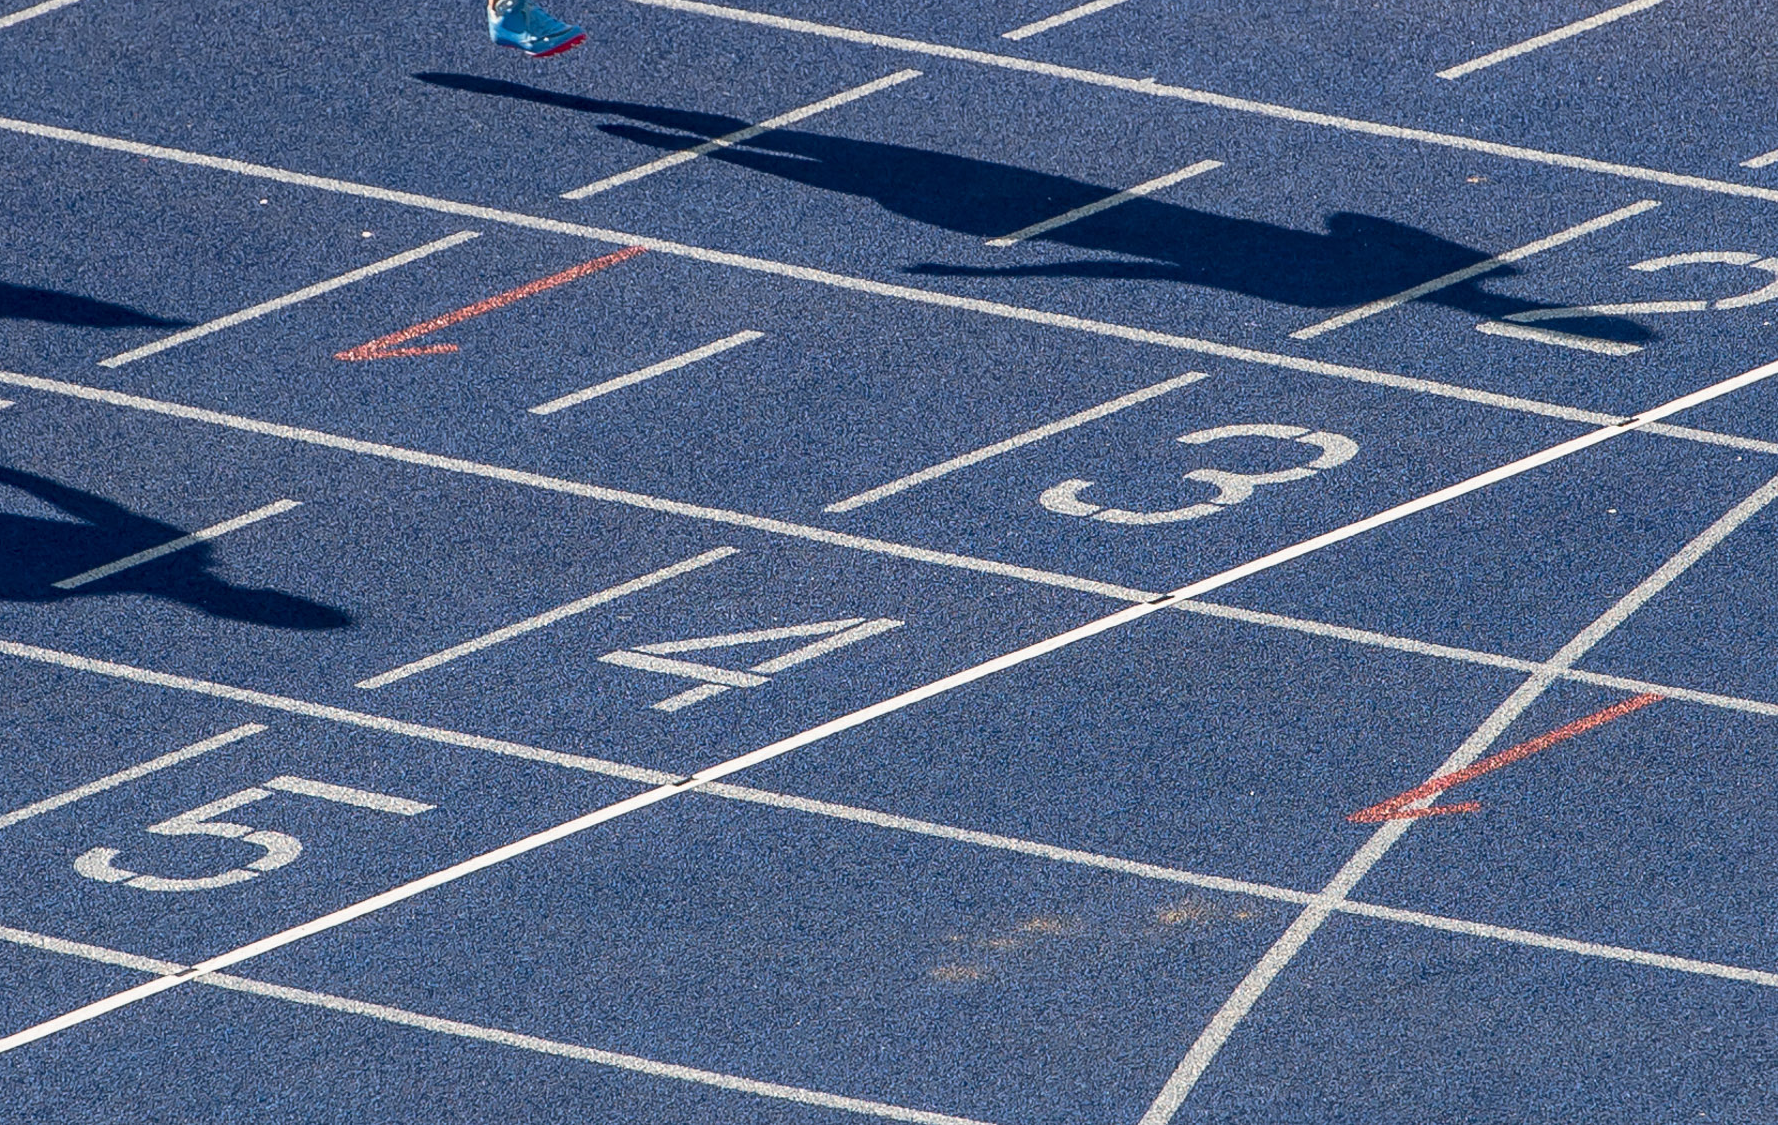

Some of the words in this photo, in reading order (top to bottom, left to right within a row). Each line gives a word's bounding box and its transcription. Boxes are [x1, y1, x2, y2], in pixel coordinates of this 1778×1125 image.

[1038, 422, 1360, 525] 3
[598, 617, 905, 713] 4
[73, 775, 436, 892] 5
